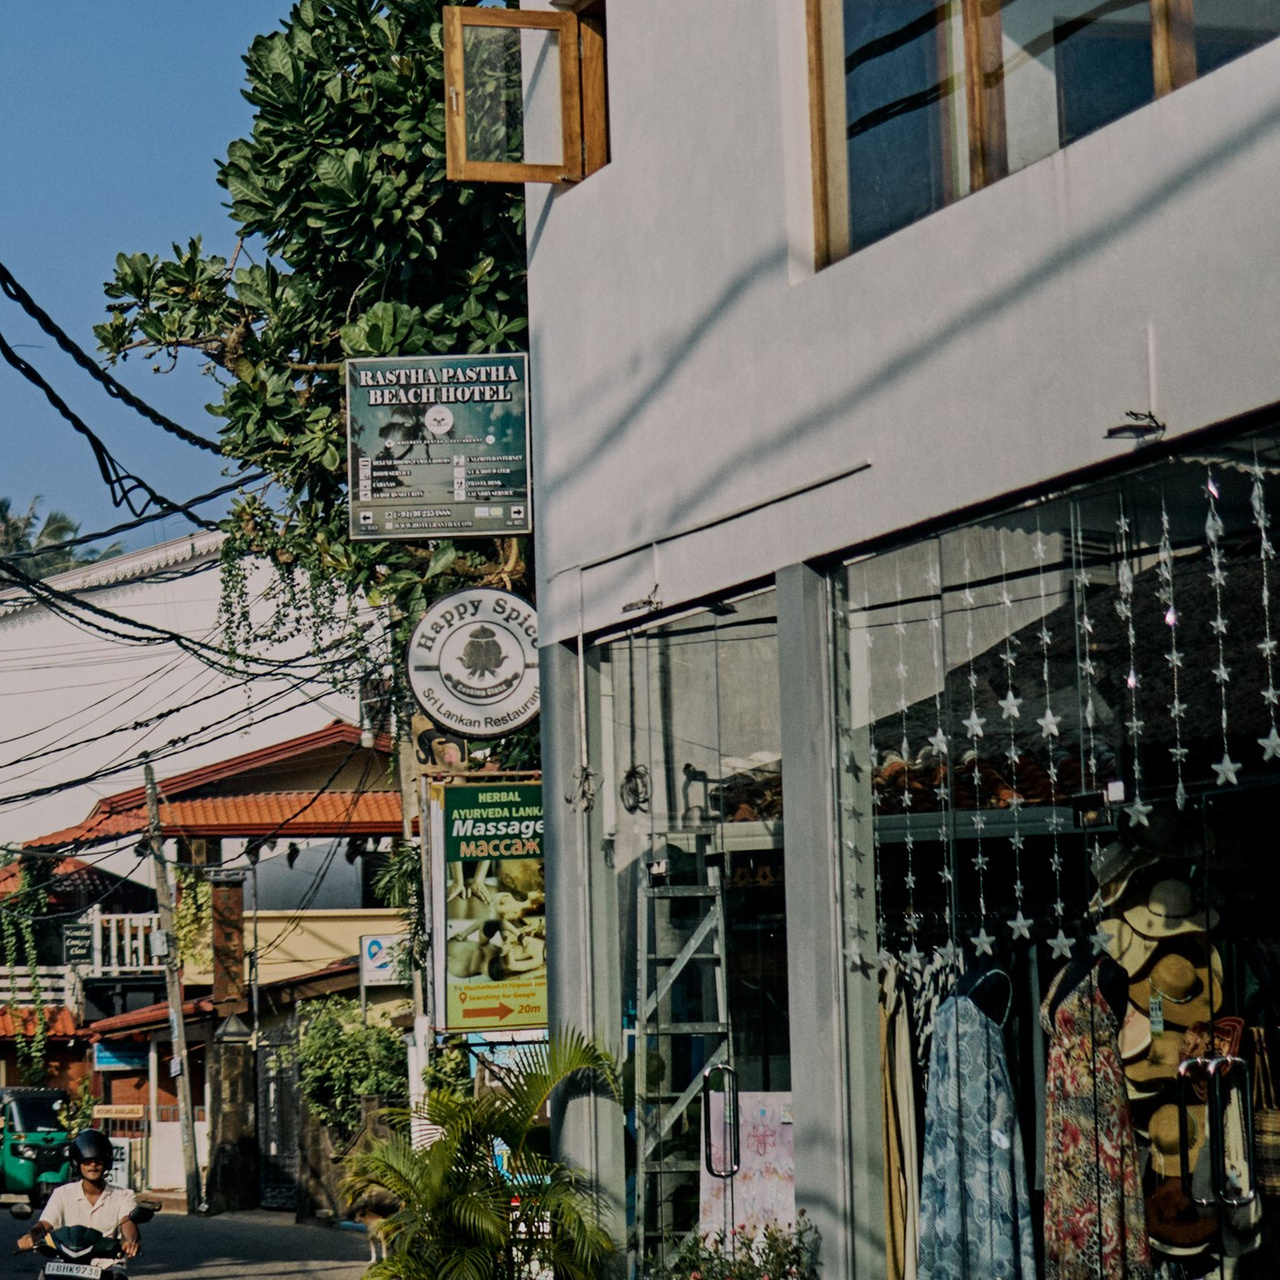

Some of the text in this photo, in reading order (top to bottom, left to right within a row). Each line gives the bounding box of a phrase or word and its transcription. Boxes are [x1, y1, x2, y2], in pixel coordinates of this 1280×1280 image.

[359, 365, 519, 387] RASTHA PASTHA
[368, 385, 512, 406] BEACH HOTEL
[417, 599, 483, 653] Happy
[422, 687, 439, 707] Sri
[436, 703, 481, 729] Lankan
[478, 791, 522, 803] HERBAL
[451, 807, 510, 820] AYURVEDA
[451, 819, 545, 838] Massage
[517, 1004, 541, 1014] 20m
